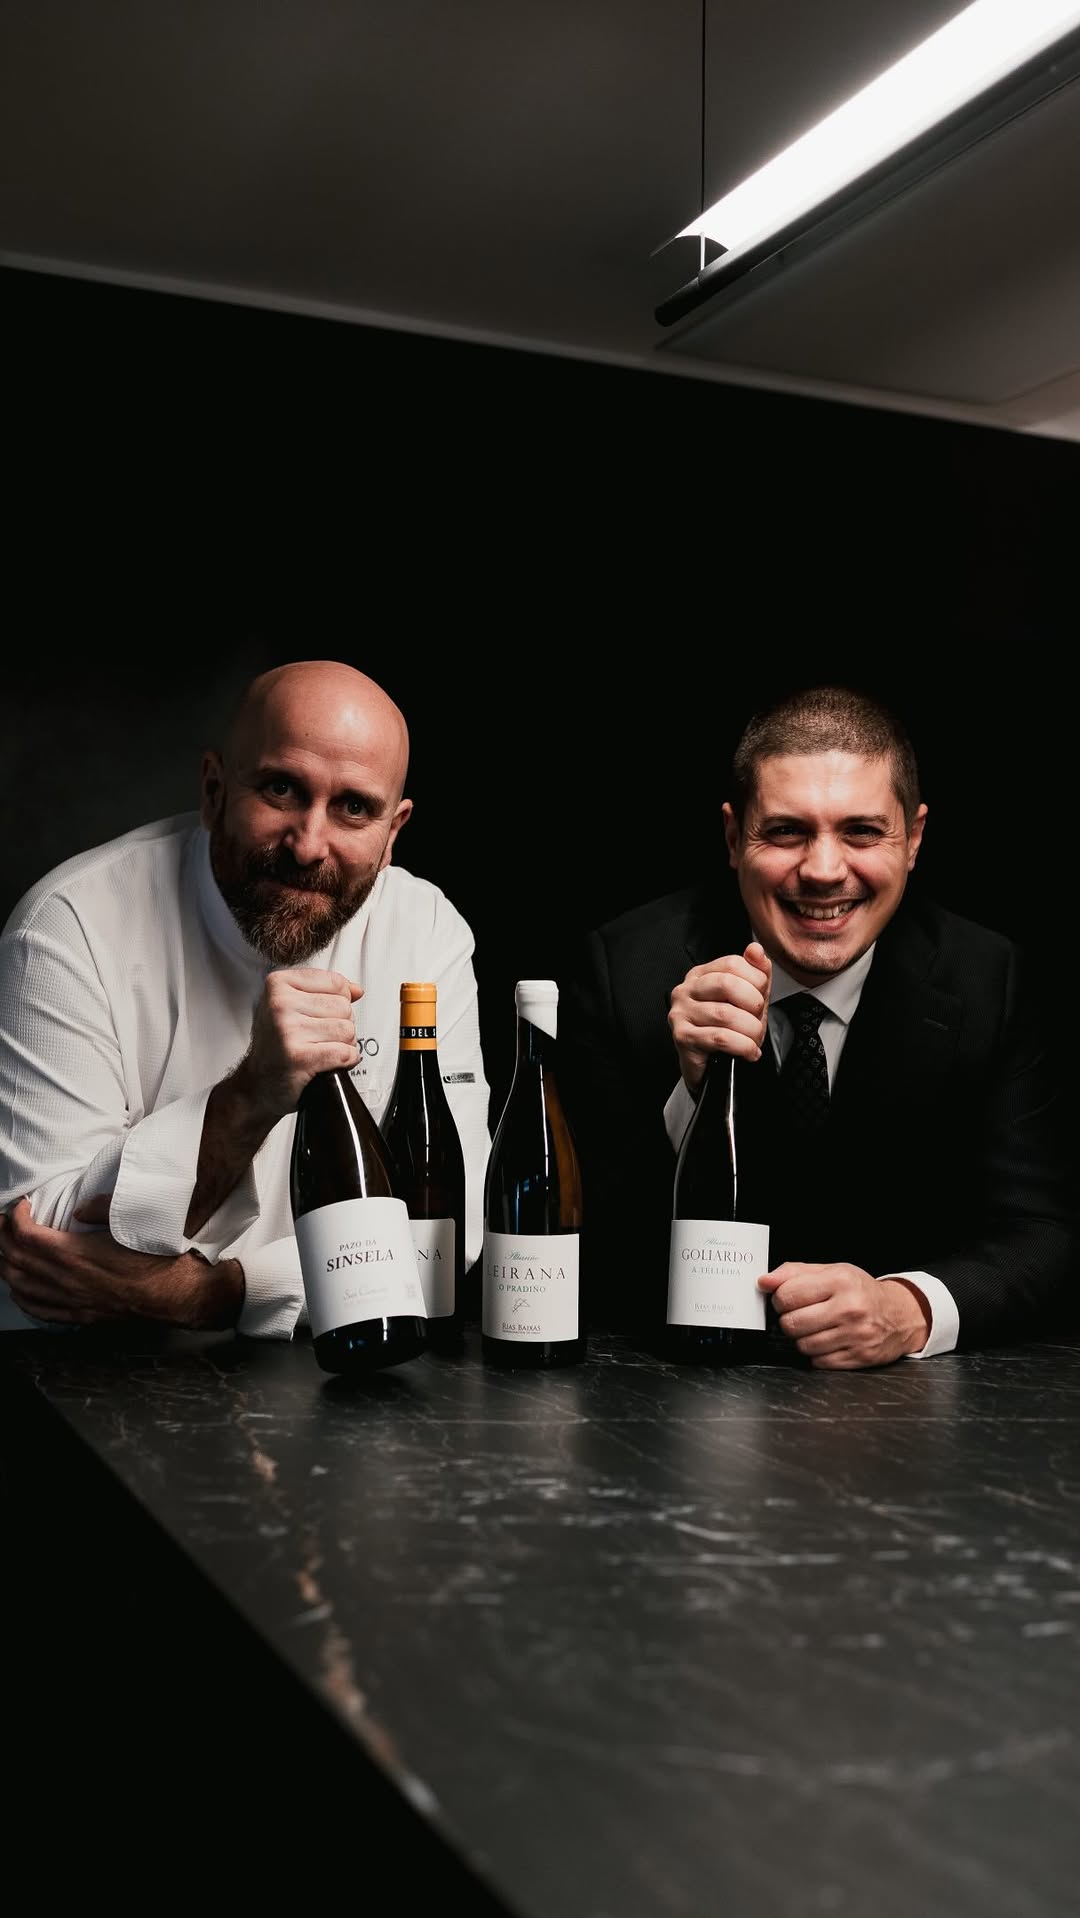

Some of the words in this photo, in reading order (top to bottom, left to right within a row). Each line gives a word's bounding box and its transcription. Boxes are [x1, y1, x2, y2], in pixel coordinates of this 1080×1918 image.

[411, 1028, 429, 1037] DEL
[339, 1241, 362, 1251] PAZO
[365, 1239, 377, 1247] DA
[326, 1249, 394, 1272] SINSELA
[681, 1248, 753, 1264] GOLIARDO
